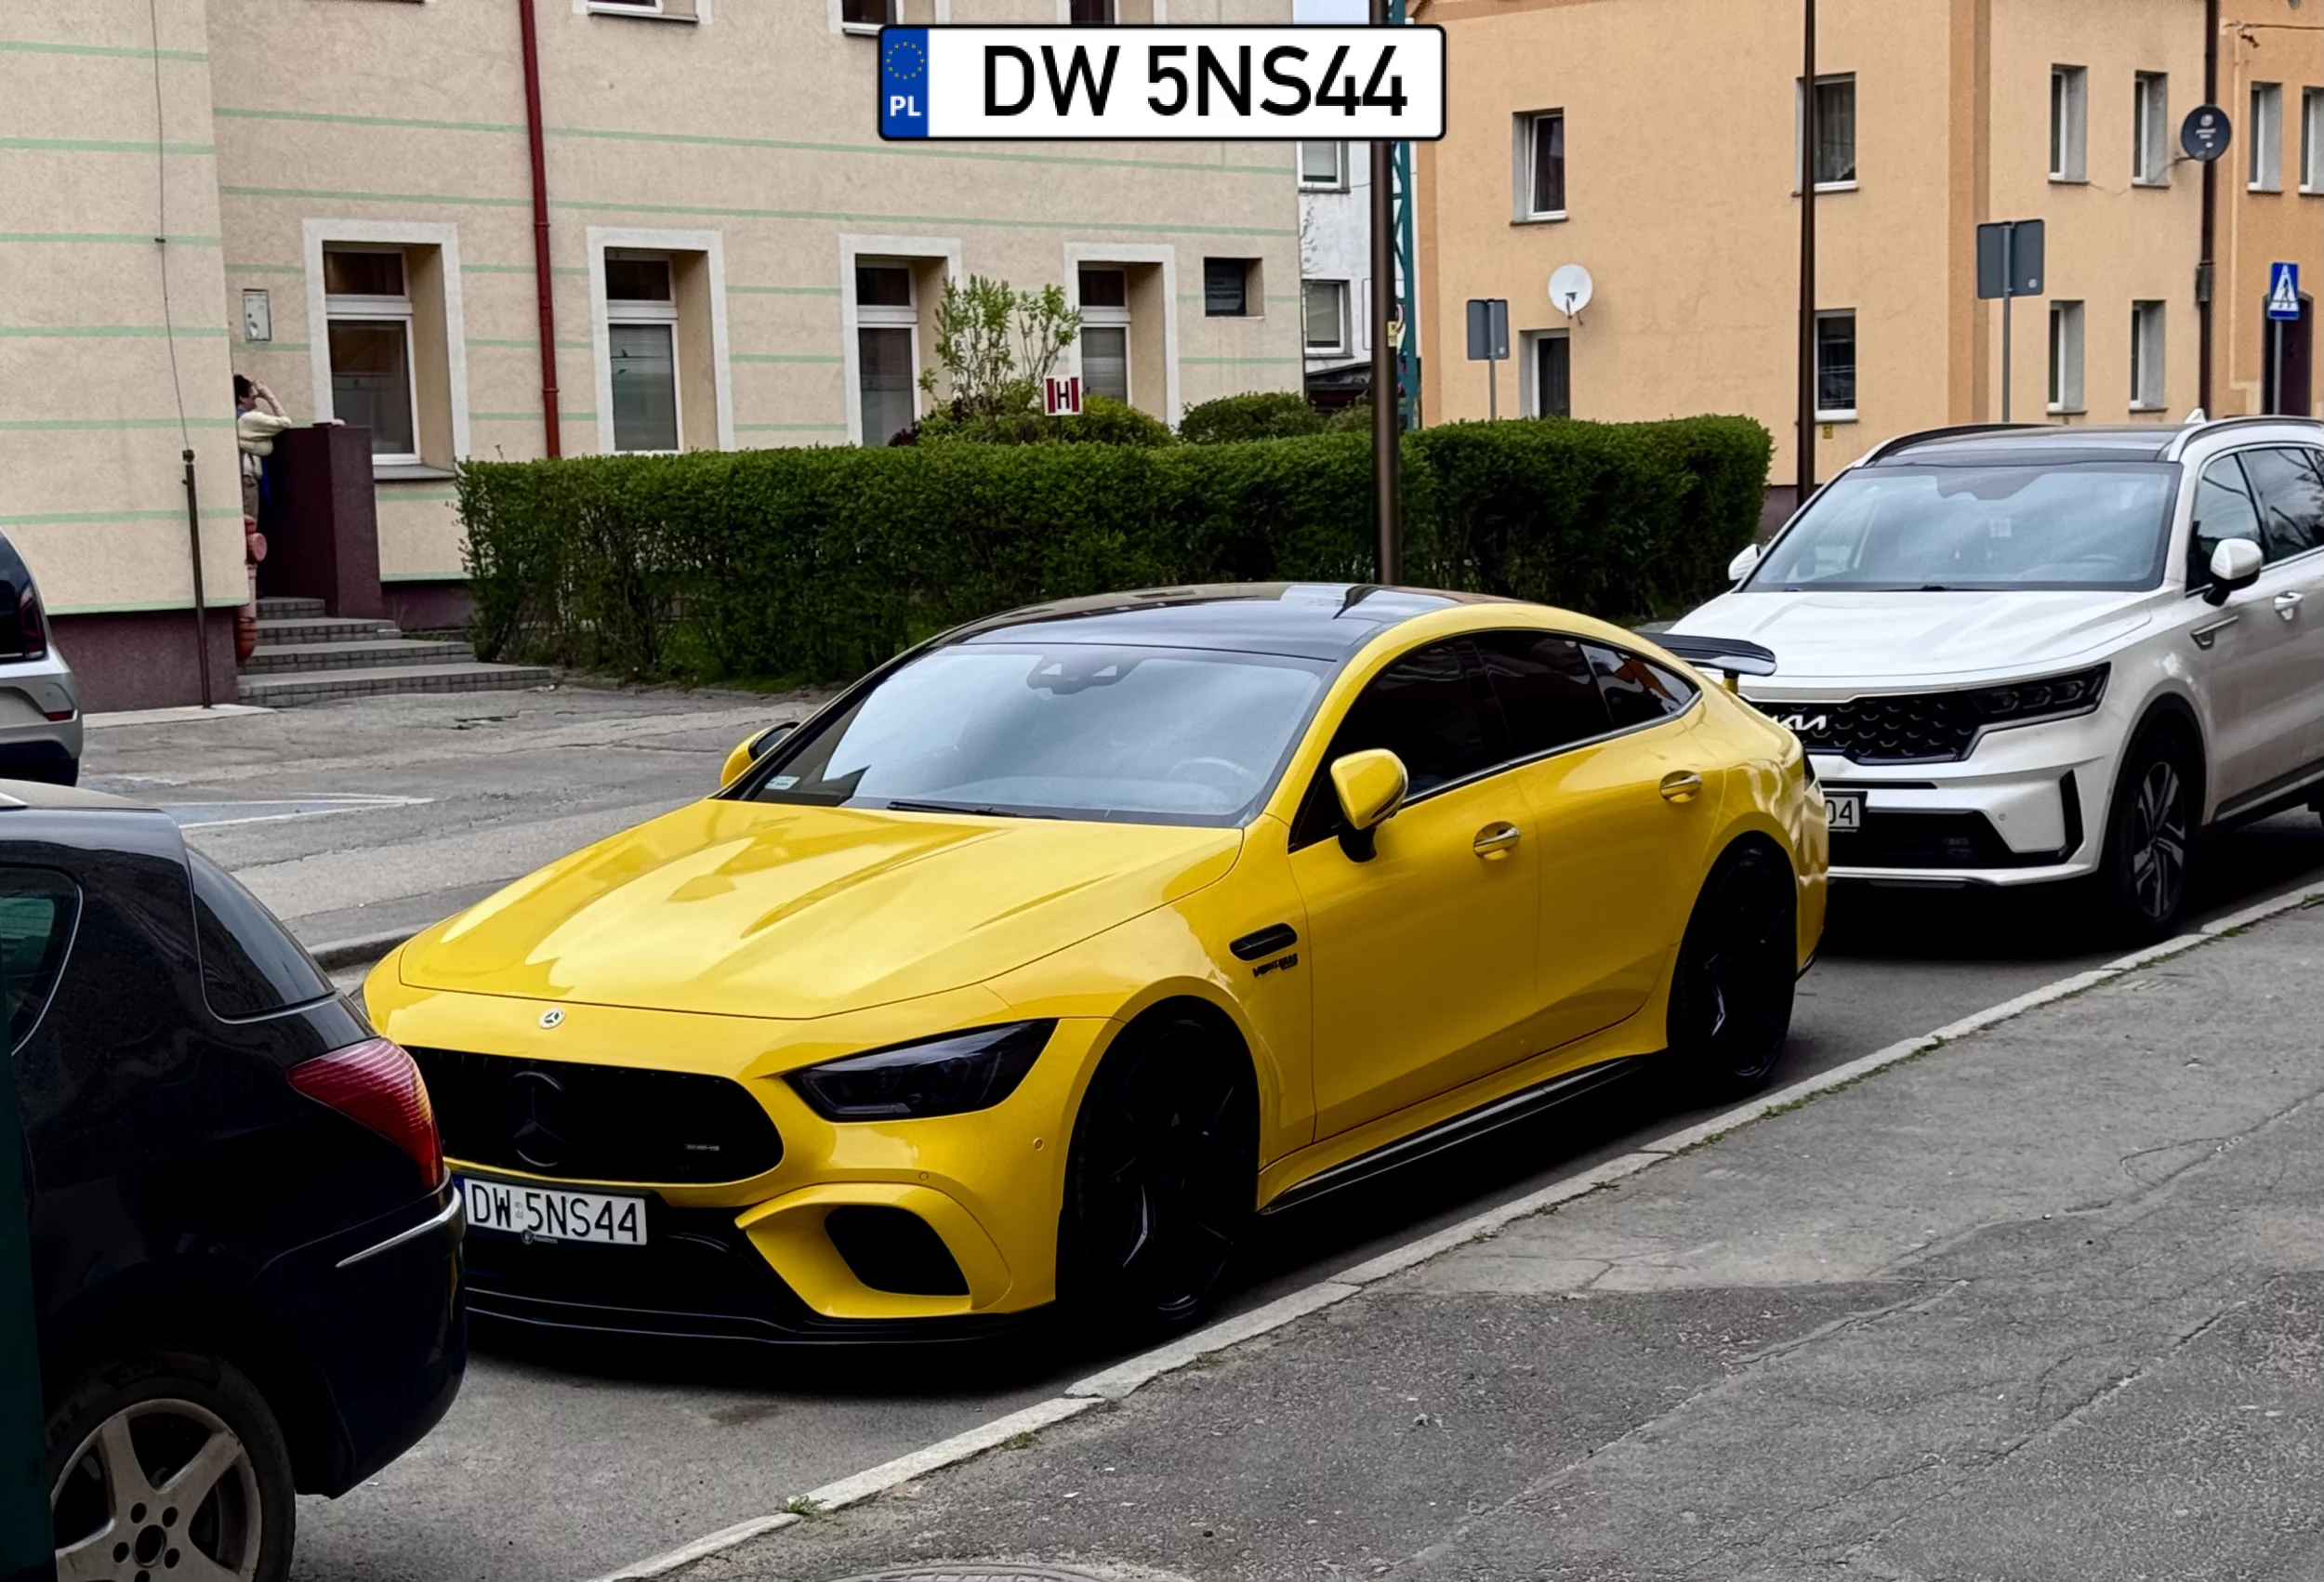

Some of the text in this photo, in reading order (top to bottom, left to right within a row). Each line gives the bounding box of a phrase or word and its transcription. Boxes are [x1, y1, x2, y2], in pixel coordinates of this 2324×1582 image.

[1056, 381, 1070, 410] H
[471, 1183, 638, 1243] DW 5NS44
